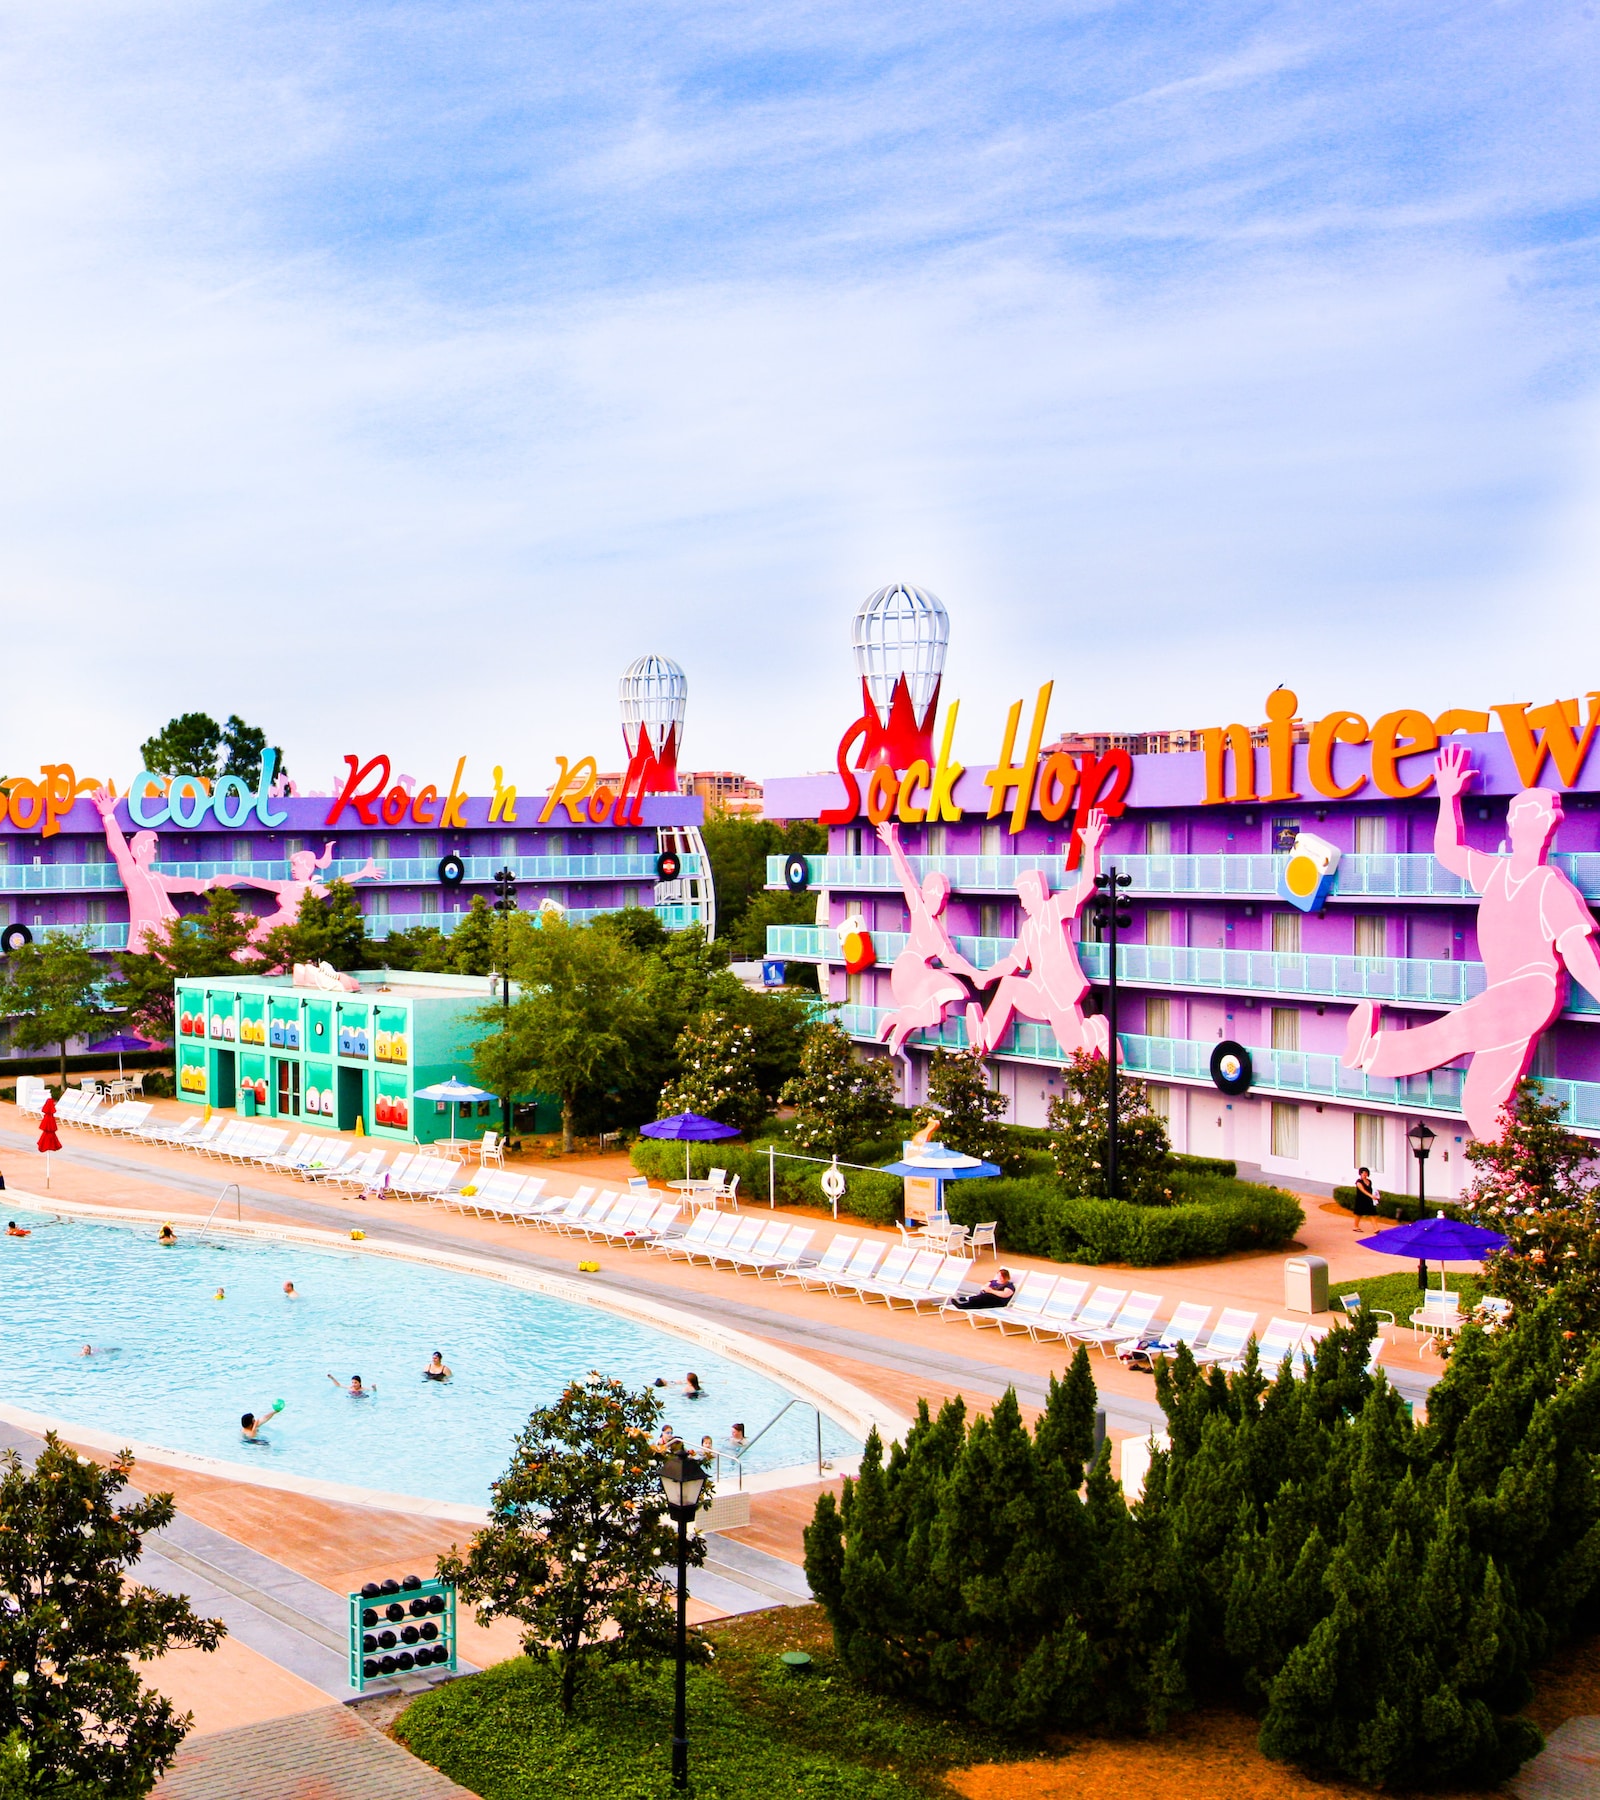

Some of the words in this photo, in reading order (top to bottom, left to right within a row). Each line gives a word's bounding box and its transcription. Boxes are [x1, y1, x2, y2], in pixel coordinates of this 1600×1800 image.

[129, 747, 288, 828] cool
[325, 754, 469, 828] Rock
[538, 756, 655, 827] Roll
[818, 699, 965, 826] Sock
[984, 680, 1133, 871] Hop
[1200, 689, 1439, 805] nice
